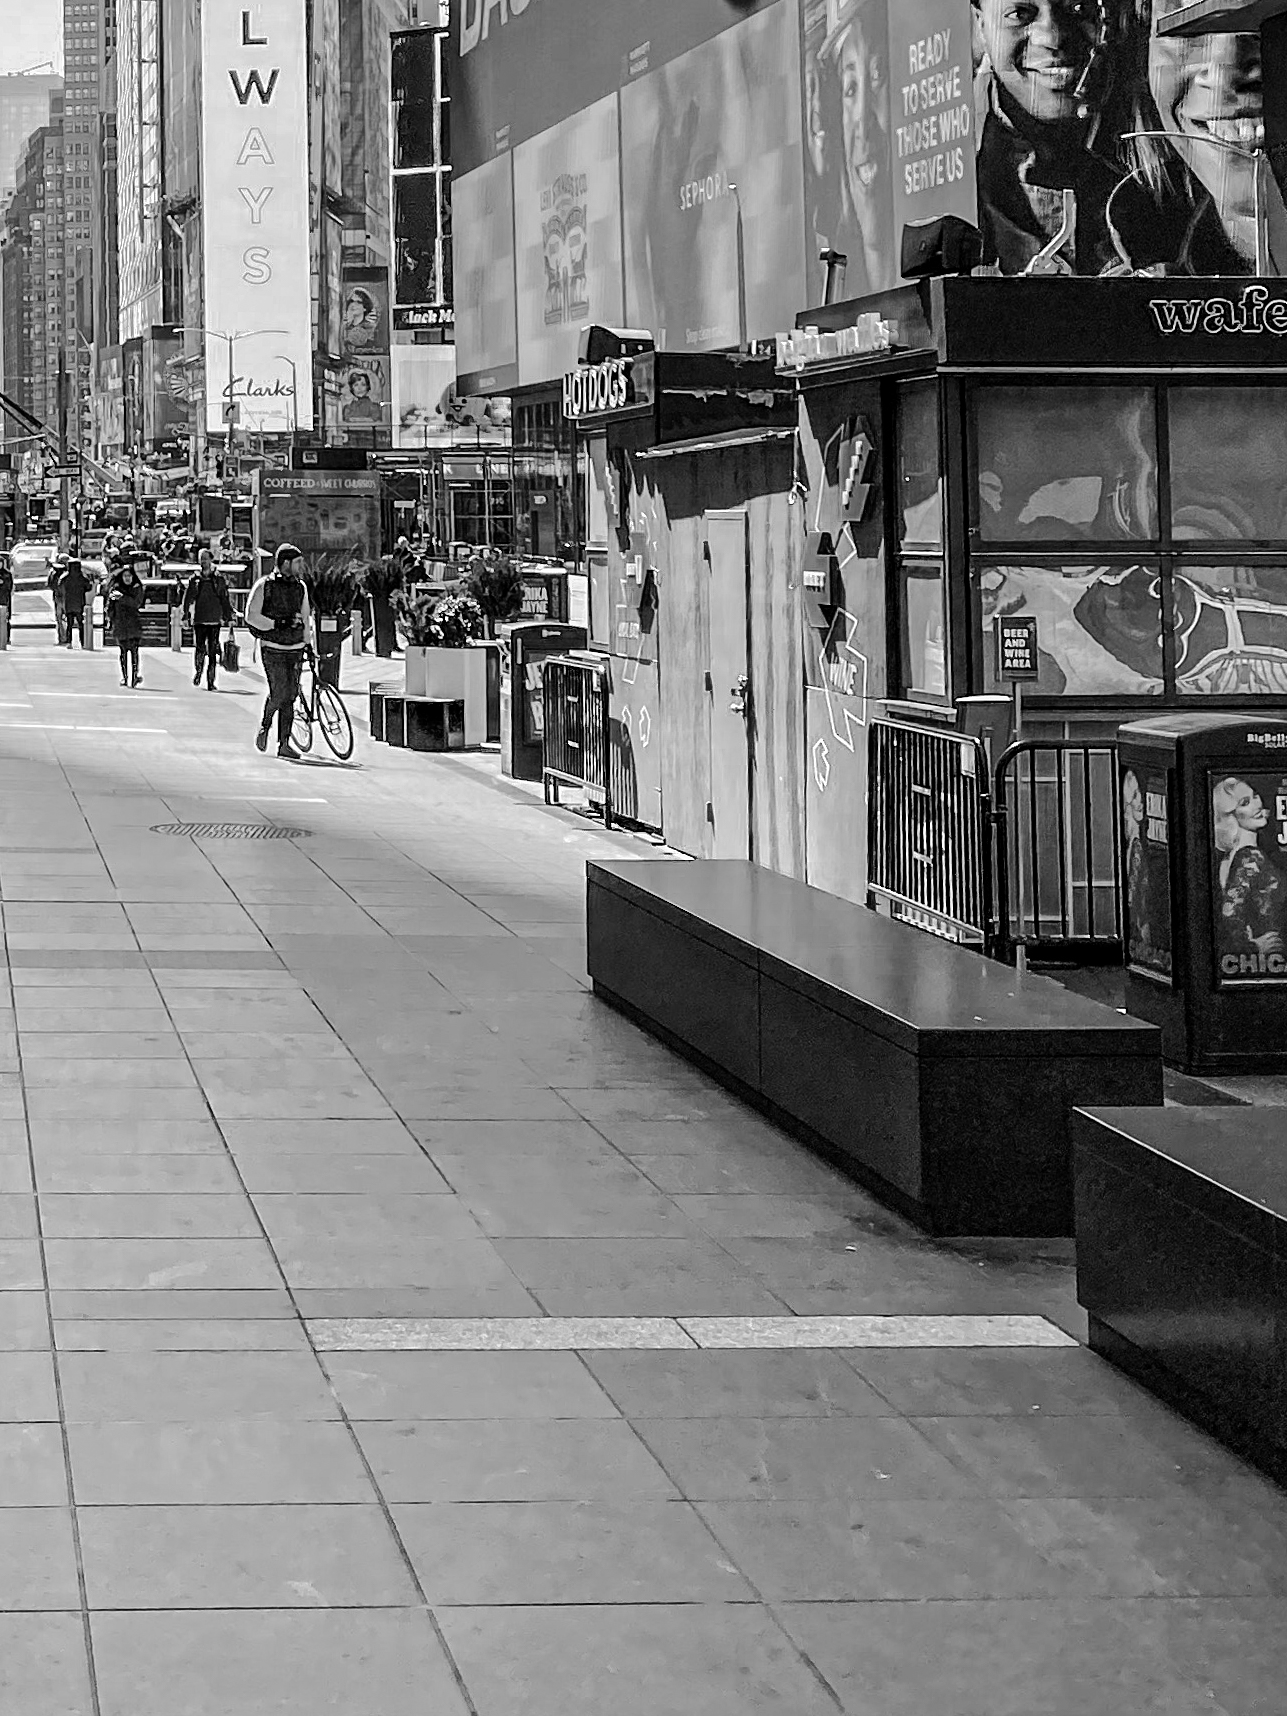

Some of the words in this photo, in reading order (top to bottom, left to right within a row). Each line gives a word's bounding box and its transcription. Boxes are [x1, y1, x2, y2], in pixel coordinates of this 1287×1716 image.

[908, 28, 952, 75] READY
[901, 85, 919, 116] TO
[919, 65, 962, 111] SERVE
[895, 116, 940, 159] THOSE
[941, 102, 970, 142] WHO
[904, 154, 945, 195] SERVE
[946, 148, 964, 183] US
[679, 170, 729, 211] SEPHORA
[1151, 286, 1287, 335] wafe
[223, 376, 295, 397] Clarks
[263, 477, 316, 489] COFFEED
[523, 587, 548, 601] RIKA
[1003, 628, 1029, 638] BEER
[1004, 638, 1026, 648] AND
[1004, 648, 1031, 659] WINE
[1004, 658, 1031, 669] AREA
[1221, 953, 1287, 975] CHIC
